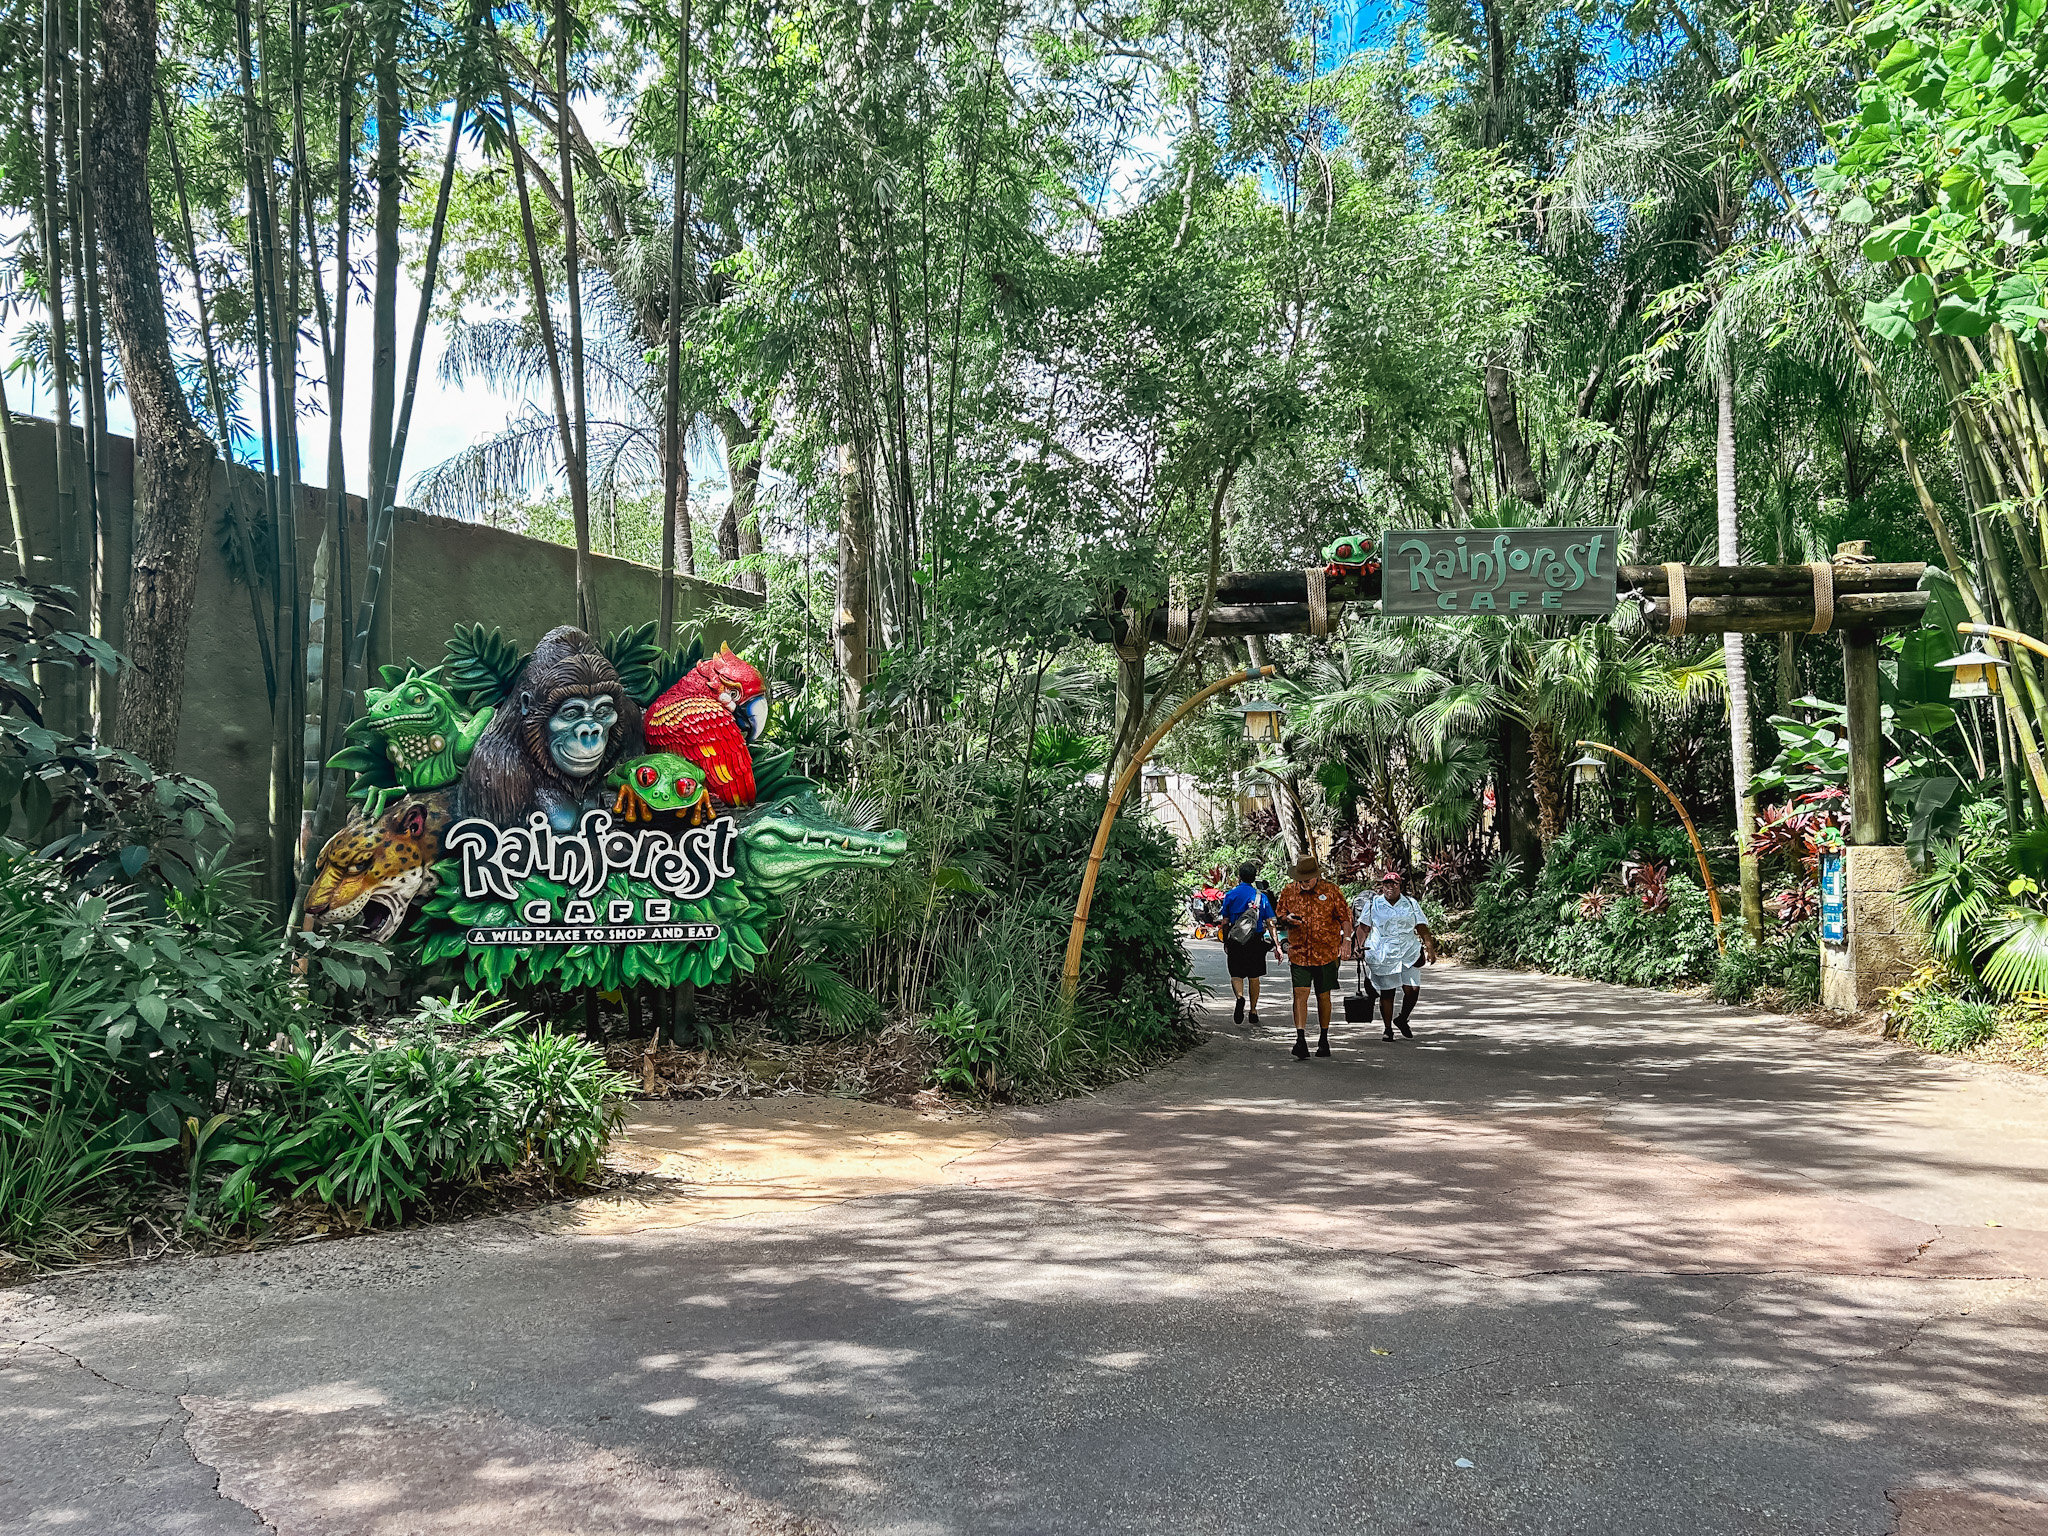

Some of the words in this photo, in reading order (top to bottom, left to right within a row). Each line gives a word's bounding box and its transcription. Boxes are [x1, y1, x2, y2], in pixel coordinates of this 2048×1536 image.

[1398, 534, 1606, 592] Rainforest
[1436, 591, 1563, 610] CAFE
[445, 810, 738, 899] Rainforest
[522, 899, 672, 923] CAFE
[473, 931, 486, 942] A
[491, 930, 532, 942] WILD
[535, 929, 580, 941] PLACE
[584, 929, 604, 941] TO
[608, 928, 646, 940] SHOP
[651, 927, 684, 939] AND
[688, 926, 714, 938] EAT
